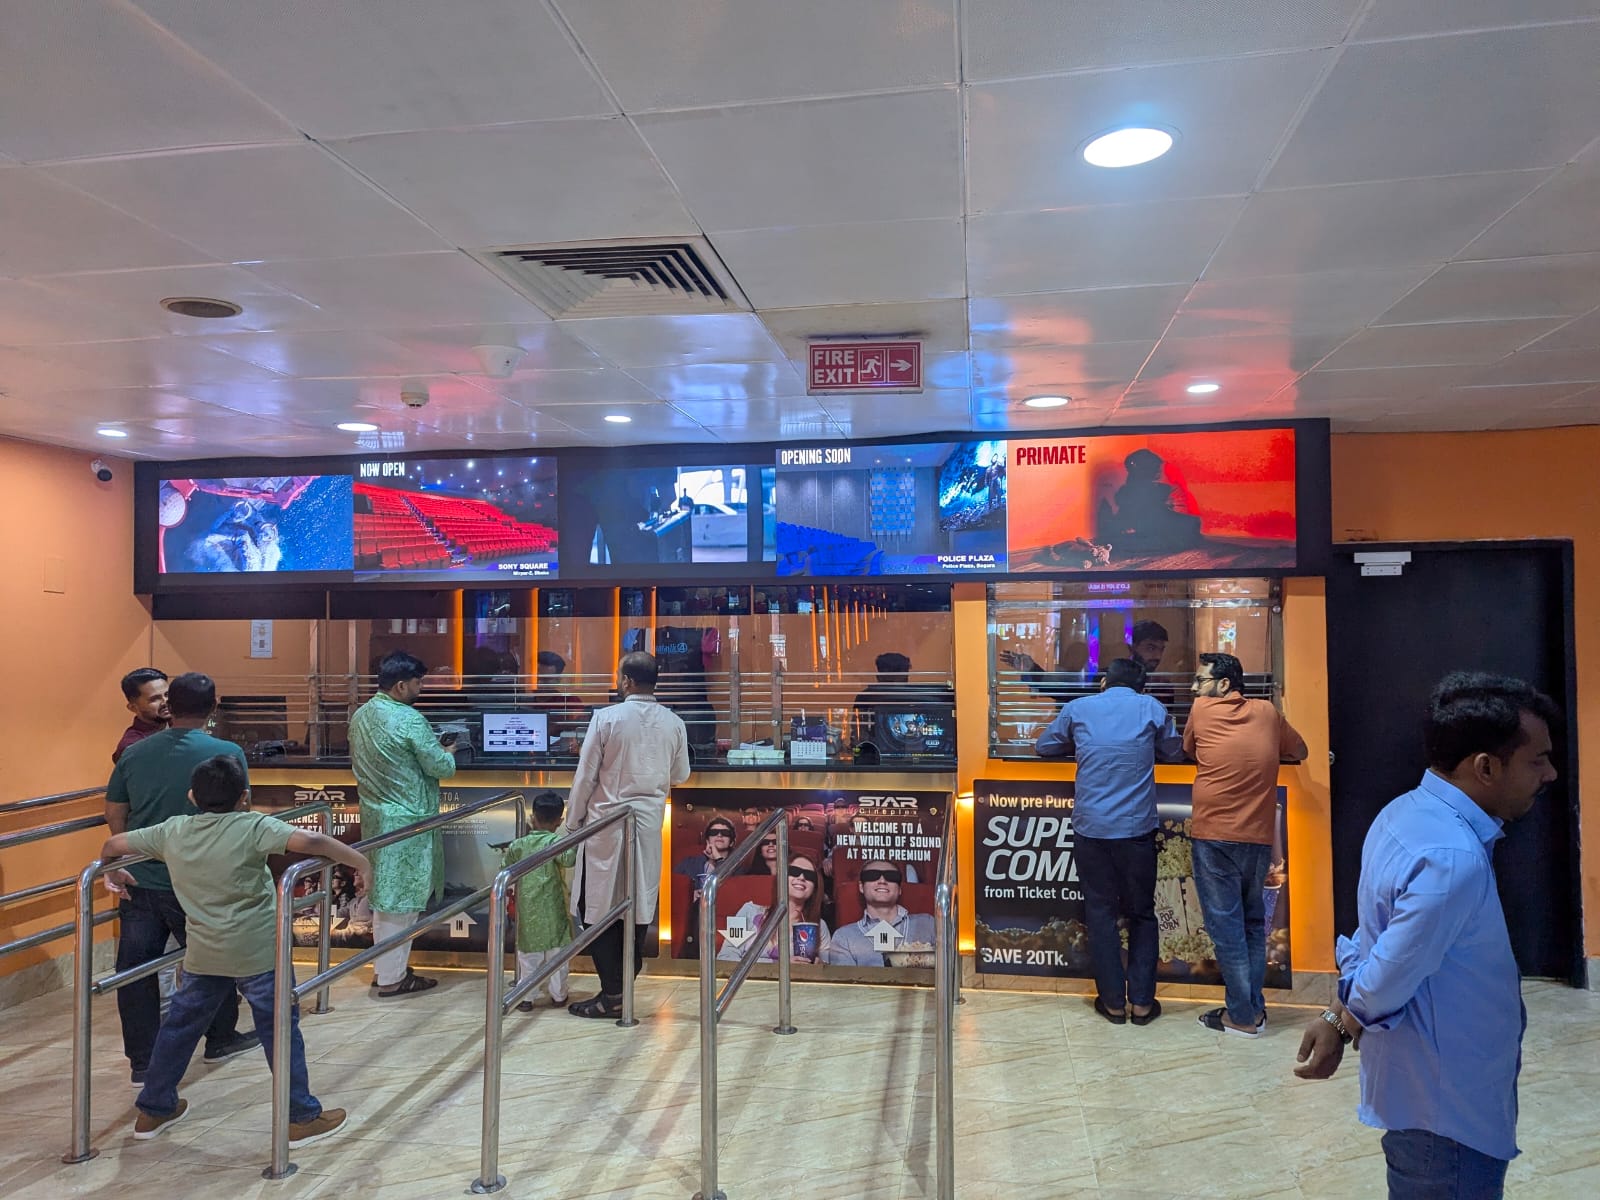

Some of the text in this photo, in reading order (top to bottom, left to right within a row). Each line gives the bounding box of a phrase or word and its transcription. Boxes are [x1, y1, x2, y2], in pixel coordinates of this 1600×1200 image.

[814, 350, 855, 365] FIRE
[814, 368, 855, 384] EXIT
[781, 447, 851, 465] OPENING SOON
[1016, 445, 1087, 466] PRIMATE
[360, 461, 405, 478] NOW OPEN
[968, 554, 995, 562] PLAZA
[519, 562, 549, 570] SQUARE
[294, 790, 346, 801] STAR
[858, 796, 918, 808] STAR
[989, 793, 1075, 812] Now pre Purc
[339, 813, 360, 824] LUXU
[854, 821, 923, 835] WELCOME TO A
[982, 815, 1075, 848] SUPE
[836, 834, 942, 848] NEW WORLD OF SOUND
[846, 848, 931, 861] AT STAR PREMIUM
[984, 885, 1085, 900] from Ticket Cou
[1159, 910, 1174, 921] POP
[456, 919, 464, 931] IN
[729, 927, 744, 939] OUT
[880, 932, 888, 944] IN
[981, 947, 1069, 967] SAVE 20Tk.
